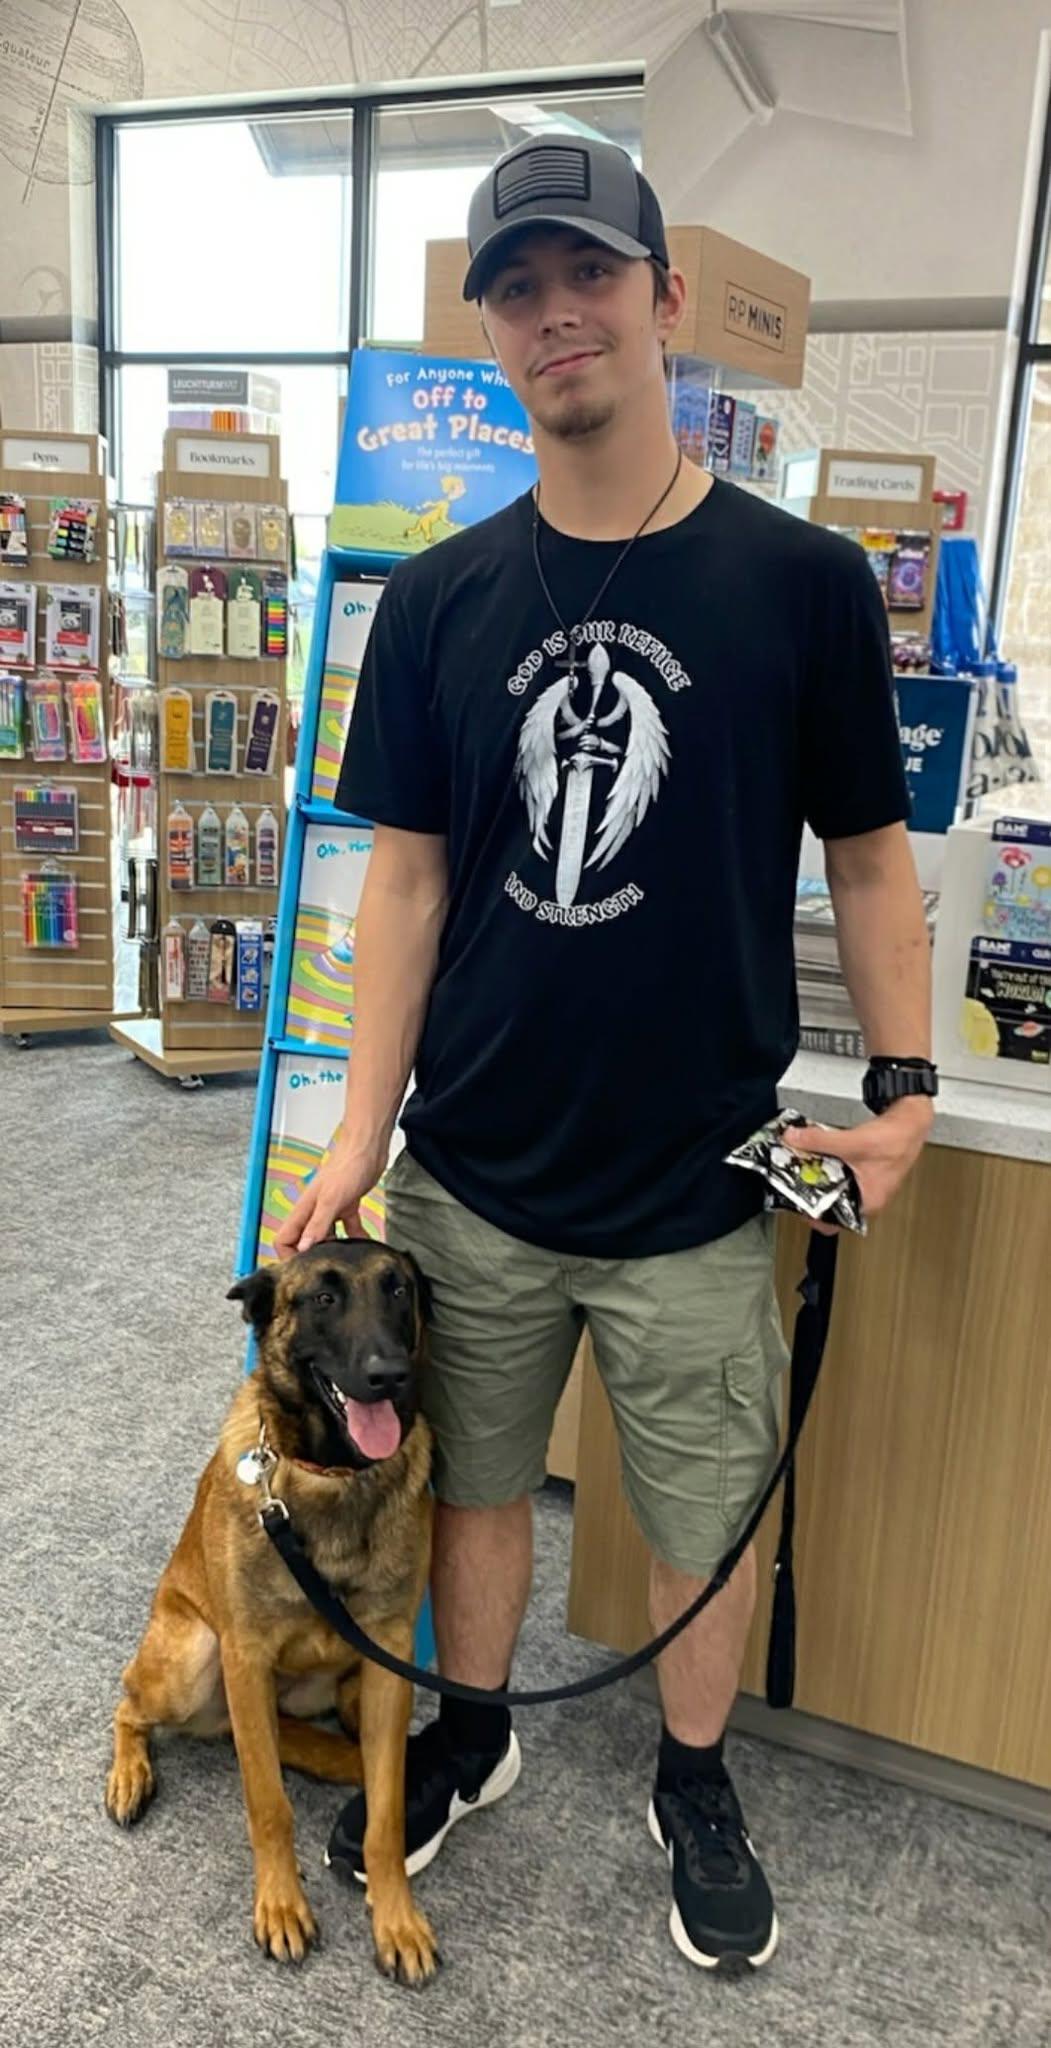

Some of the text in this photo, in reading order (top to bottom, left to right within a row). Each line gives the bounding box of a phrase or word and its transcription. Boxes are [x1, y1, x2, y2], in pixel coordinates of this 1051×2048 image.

[0, 40, 50, 68] quateur
[729, 295, 783, 339] RP MINIS
[386, 372, 410, 388] For
[417, 367, 475, 383] Anyone
[412, 386, 488, 411] Off to
[357, 413, 536, 455] Great Places
[32, 451, 59, 464] Pens
[189, 450, 256, 467] Bookmarks
[833, 475, 916, 491] Trading Cards
[507, 650, 544, 696] GOD
[542, 630, 569, 657] IS
[617, 622, 692, 692] REFUGE
[535, 882, 645, 927] STRENGTH
[320, 1070, 343, 1083] the
